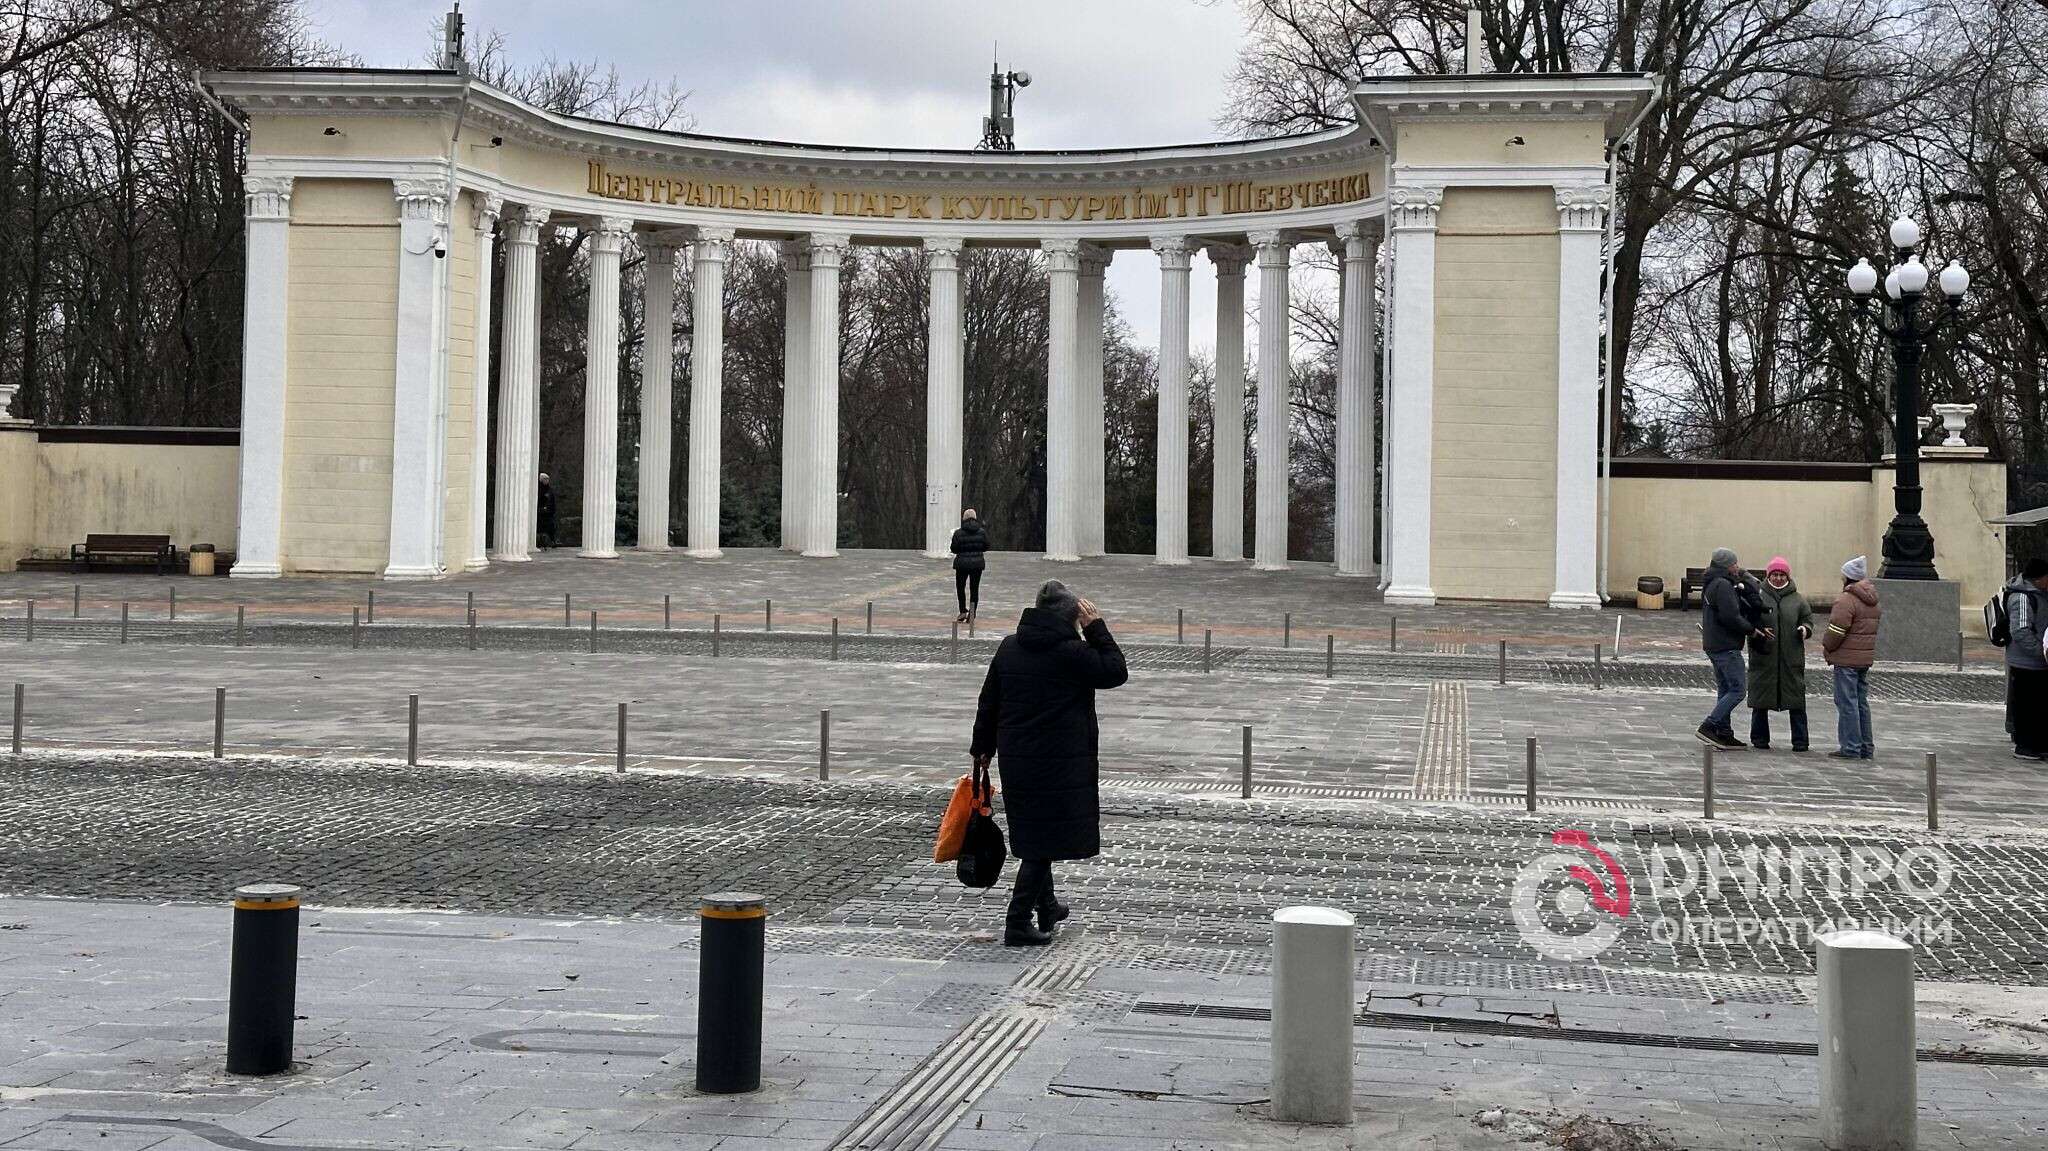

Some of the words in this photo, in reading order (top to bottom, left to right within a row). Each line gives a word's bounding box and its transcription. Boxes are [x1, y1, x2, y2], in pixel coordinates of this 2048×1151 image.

[587, 159, 823, 215] ЦЕНТРАЛЬНИЙ
[833, 191, 931, 219] ПАРК
[941, 194, 1126, 220] КУЛЬТУРИ
[1221, 171, 1371, 214] ШЕВЧЕНКА
